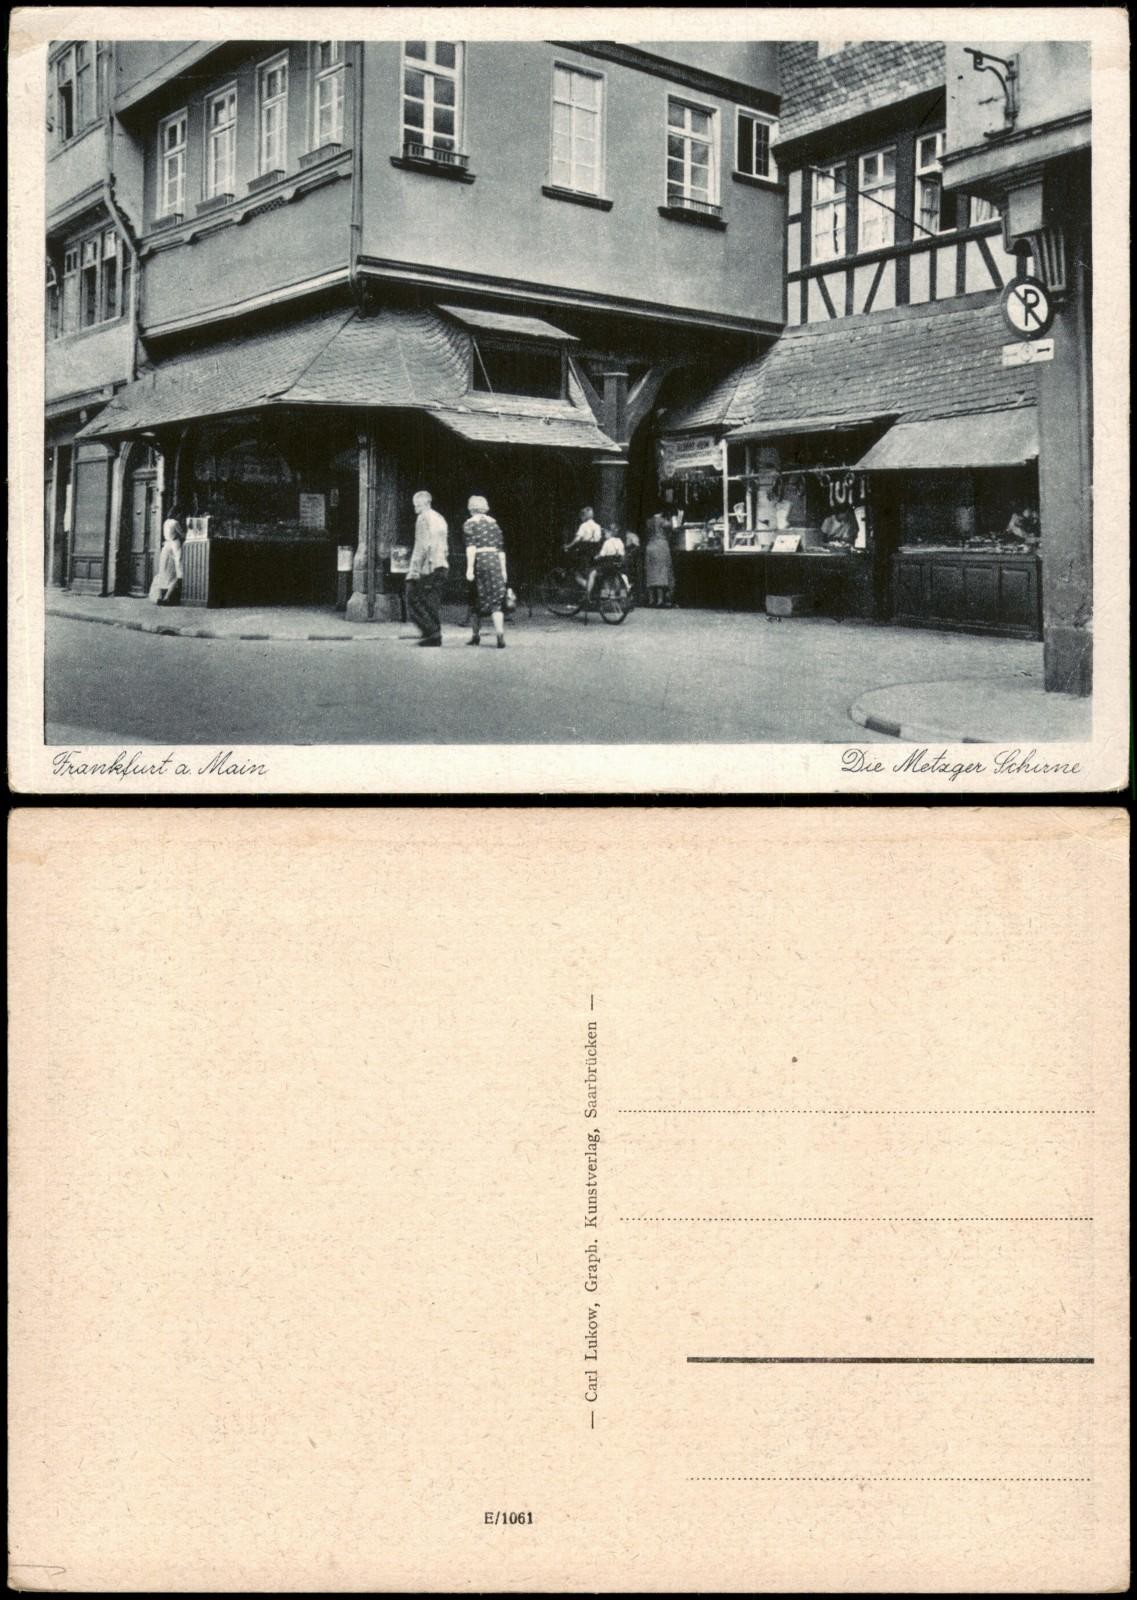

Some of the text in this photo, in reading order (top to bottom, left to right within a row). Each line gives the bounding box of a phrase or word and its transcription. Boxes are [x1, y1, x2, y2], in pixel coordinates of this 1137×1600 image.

[584, 1021, 601, 1403] Carl Lukow, Graph. Kunstverlag, Saarbrücken
[484, 1510, 533, 1526] E/1061
